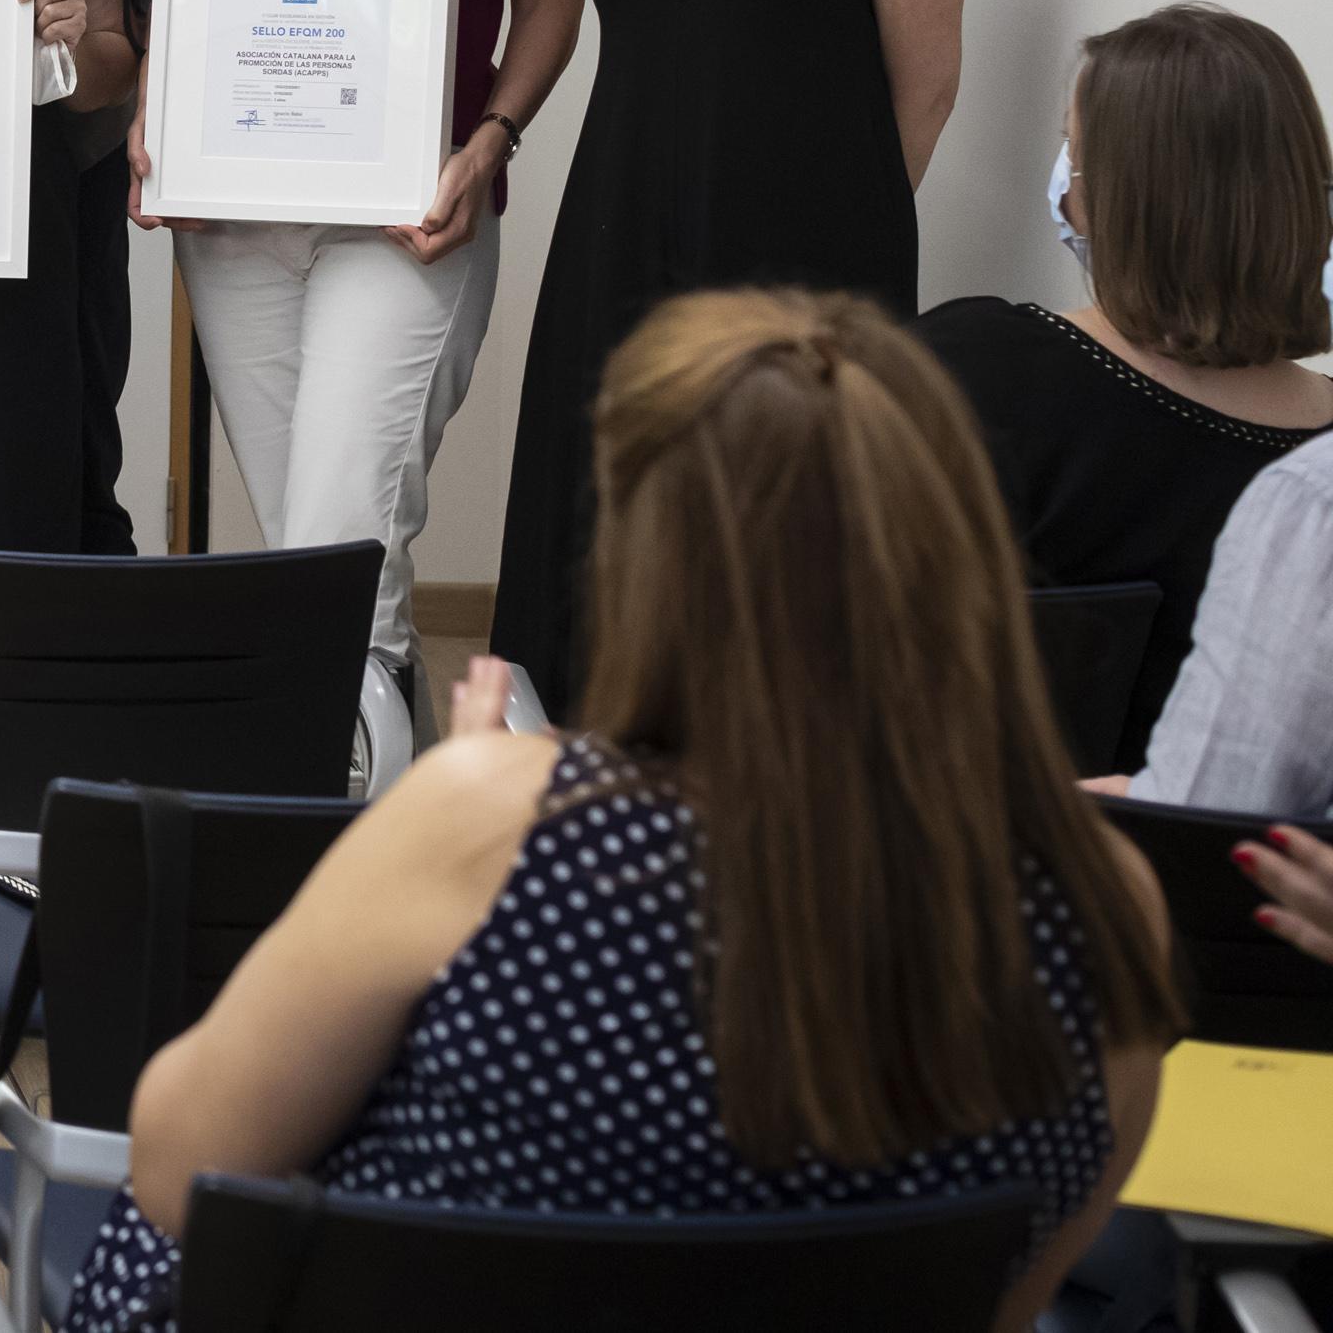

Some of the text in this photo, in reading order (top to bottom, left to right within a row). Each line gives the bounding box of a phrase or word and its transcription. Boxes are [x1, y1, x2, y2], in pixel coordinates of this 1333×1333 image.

[252, 27, 345, 38] SELLO EFQM 200
[237, 51, 281, 59] ASOCIACIÓN
[238, 59, 282, 67] PROMOCIÓN
[294, 70, 329, 78] (ACAPPS)
